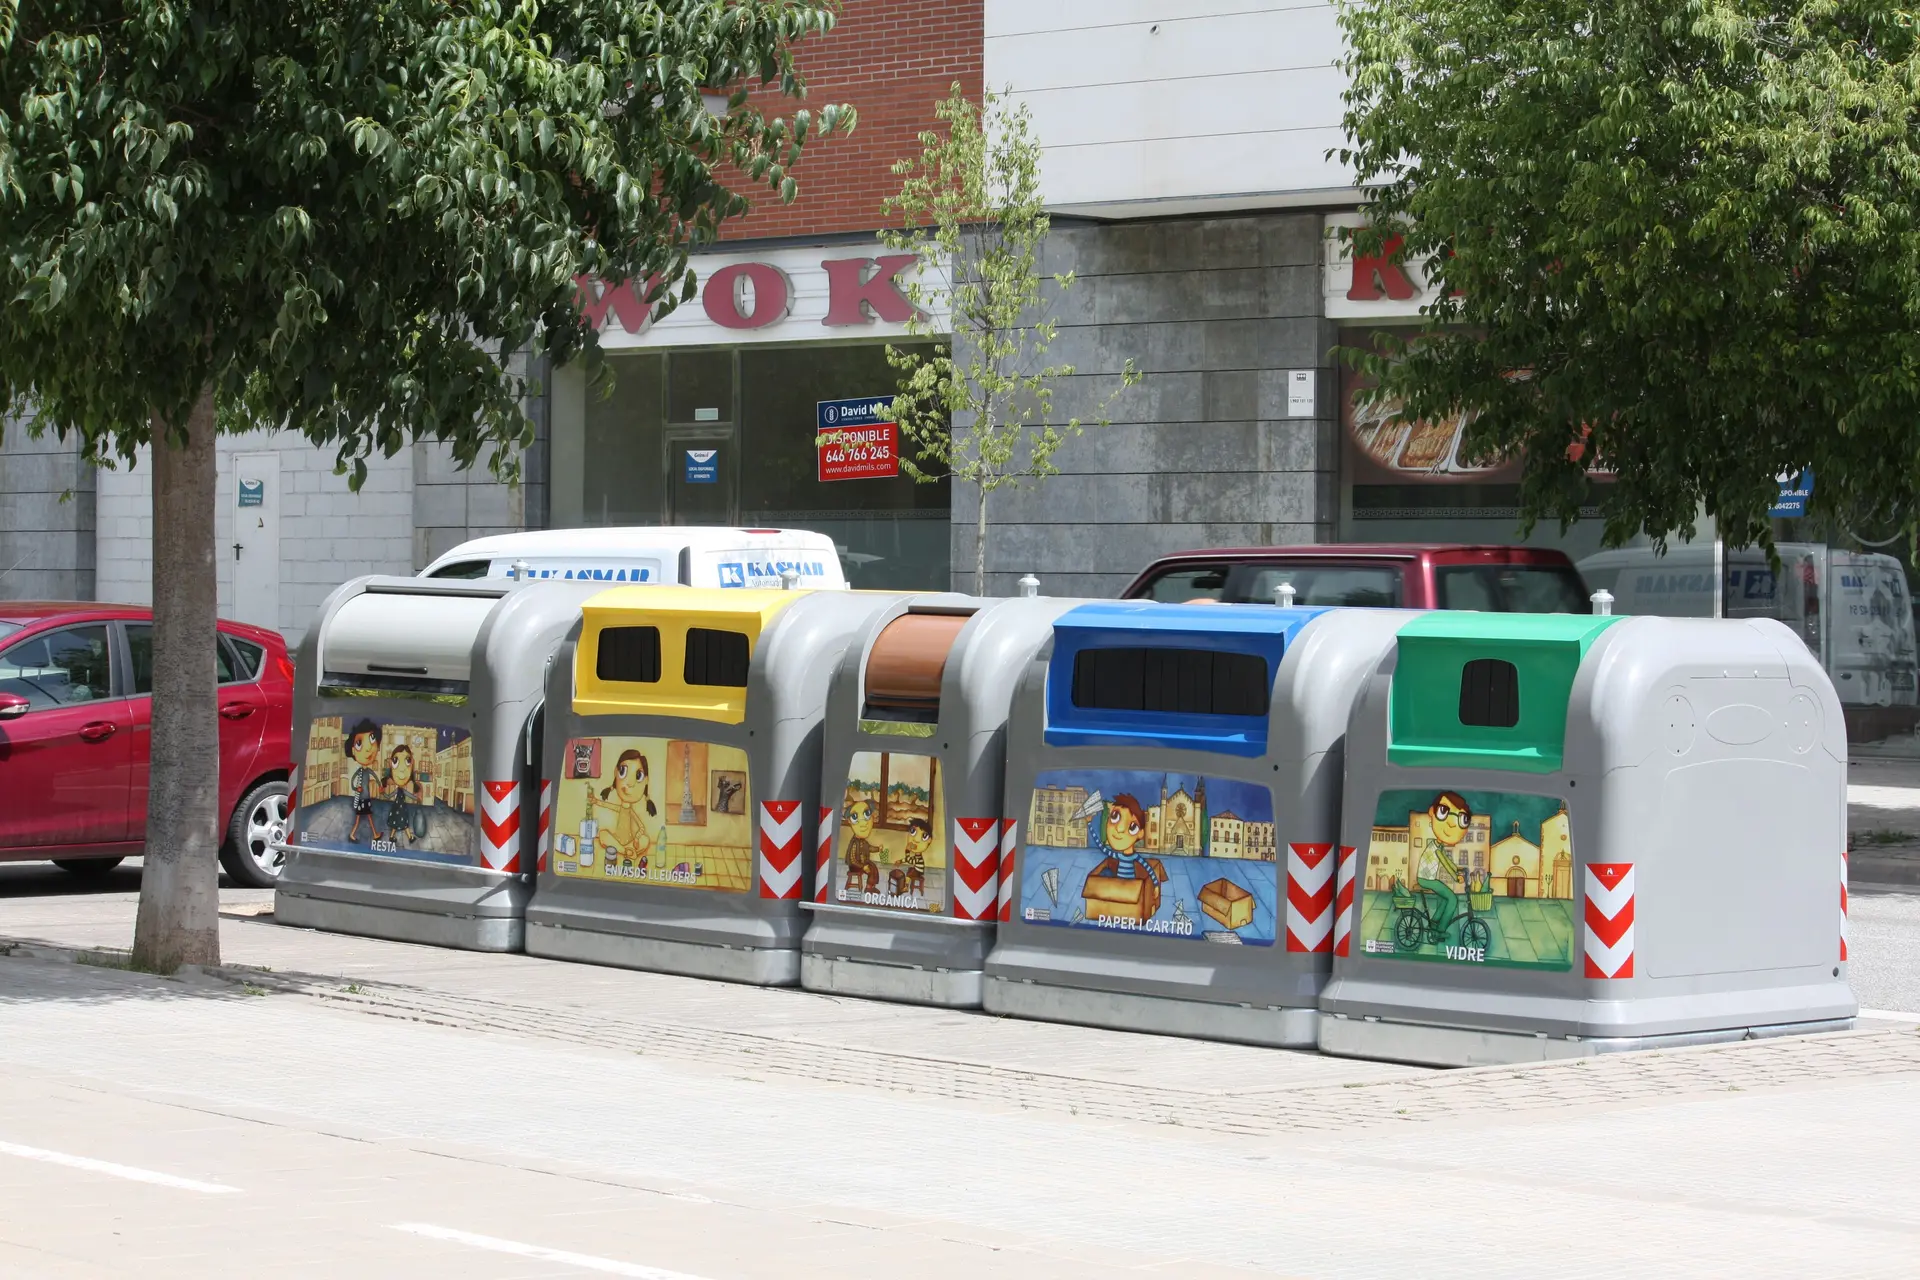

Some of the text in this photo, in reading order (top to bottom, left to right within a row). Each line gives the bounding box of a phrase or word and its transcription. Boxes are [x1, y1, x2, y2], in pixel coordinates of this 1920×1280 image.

[571, 253, 930, 335] WOK
[841, 405, 866, 417] David
[825, 429, 890, 445] DSPONIBLE
[826, 446, 889, 463] 646 766 245
[825, 463, 891, 474] www.davidmils.com
[371, 840, 397, 853] RESTA
[605, 864, 696, 884] ENVASOS LLEUGERS
[864, 890, 919, 909] ORGÀNICA
[1098, 914, 1192, 935] PAPER I CARTRÓ
[1445, 945, 1485, 962] VIDRE
